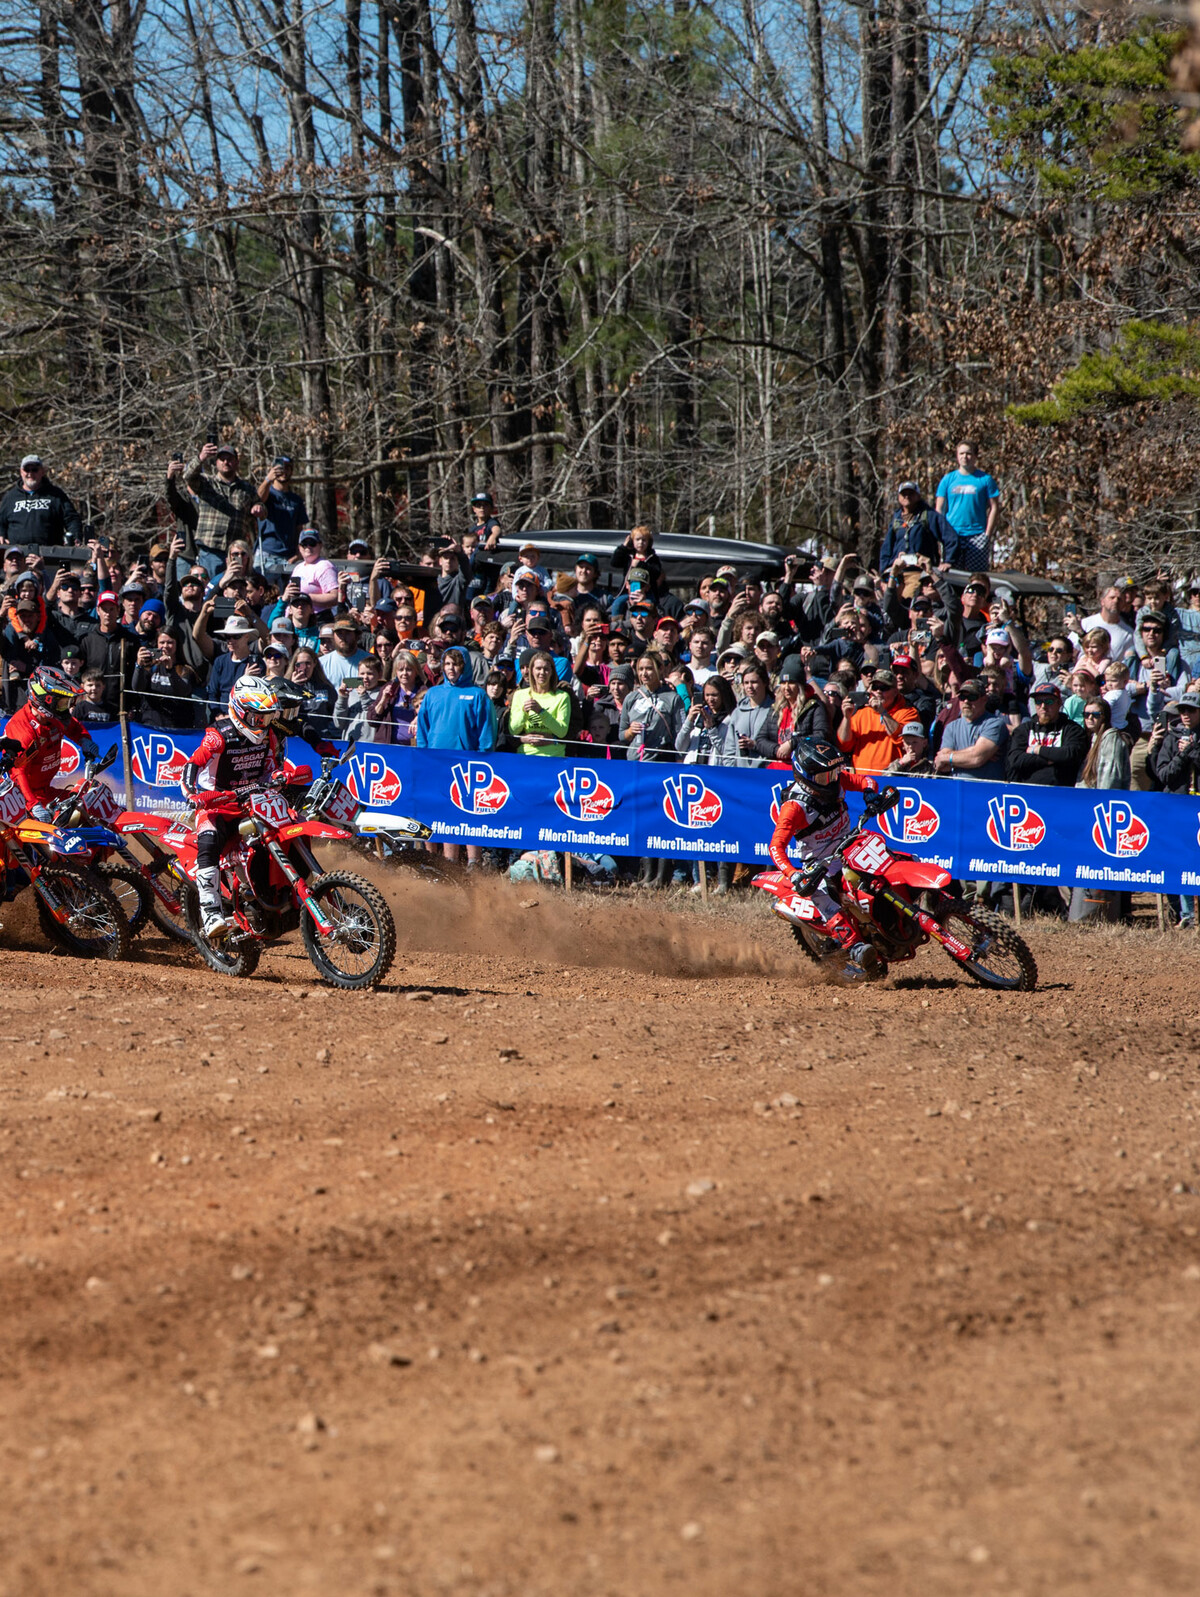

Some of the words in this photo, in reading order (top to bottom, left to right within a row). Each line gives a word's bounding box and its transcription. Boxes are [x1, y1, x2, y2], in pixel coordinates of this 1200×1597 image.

[132, 734, 174, 787] VP
[231, 752, 265, 764] GASGAS
[349, 753, 387, 806] VP
[450, 761, 494, 814] VP
[373, 783, 400, 799] Racing
[475, 790, 509, 806] Racing
[557, 767, 600, 821] VP
[372, 798, 392, 806] FUELS
[582, 797, 614, 812] Racing
[663, 773, 705, 828] VP
[261, 798, 289, 822] 212
[475, 806, 498, 814] FUELS
[581, 812, 605, 821] FUELS
[690, 804, 722, 820] Racing
[431, 821, 522, 840] #MoreThanRaceFuel
[689, 820, 713, 828] FUELS
[906, 814, 938, 832] Racing
[988, 794, 1028, 850] VP
[1094, 800, 1132, 857] VP
[538, 828, 630, 847] #MoreThanRaceFuel
[906, 834, 928, 843] FUELS
[1013, 824, 1045, 842] Racing
[1119, 831, 1149, 848] Racing
[64, 836, 83, 852] KTM
[647, 836, 739, 854] #MoreThanRaceFuel
[1013, 842, 1035, 850] FUELS
[1118, 848, 1140, 857] FUELS
[969, 858, 1060, 877] #MoreThanRaceFuel
[1076, 865, 1164, 884] #MoreThanRaceFuel
